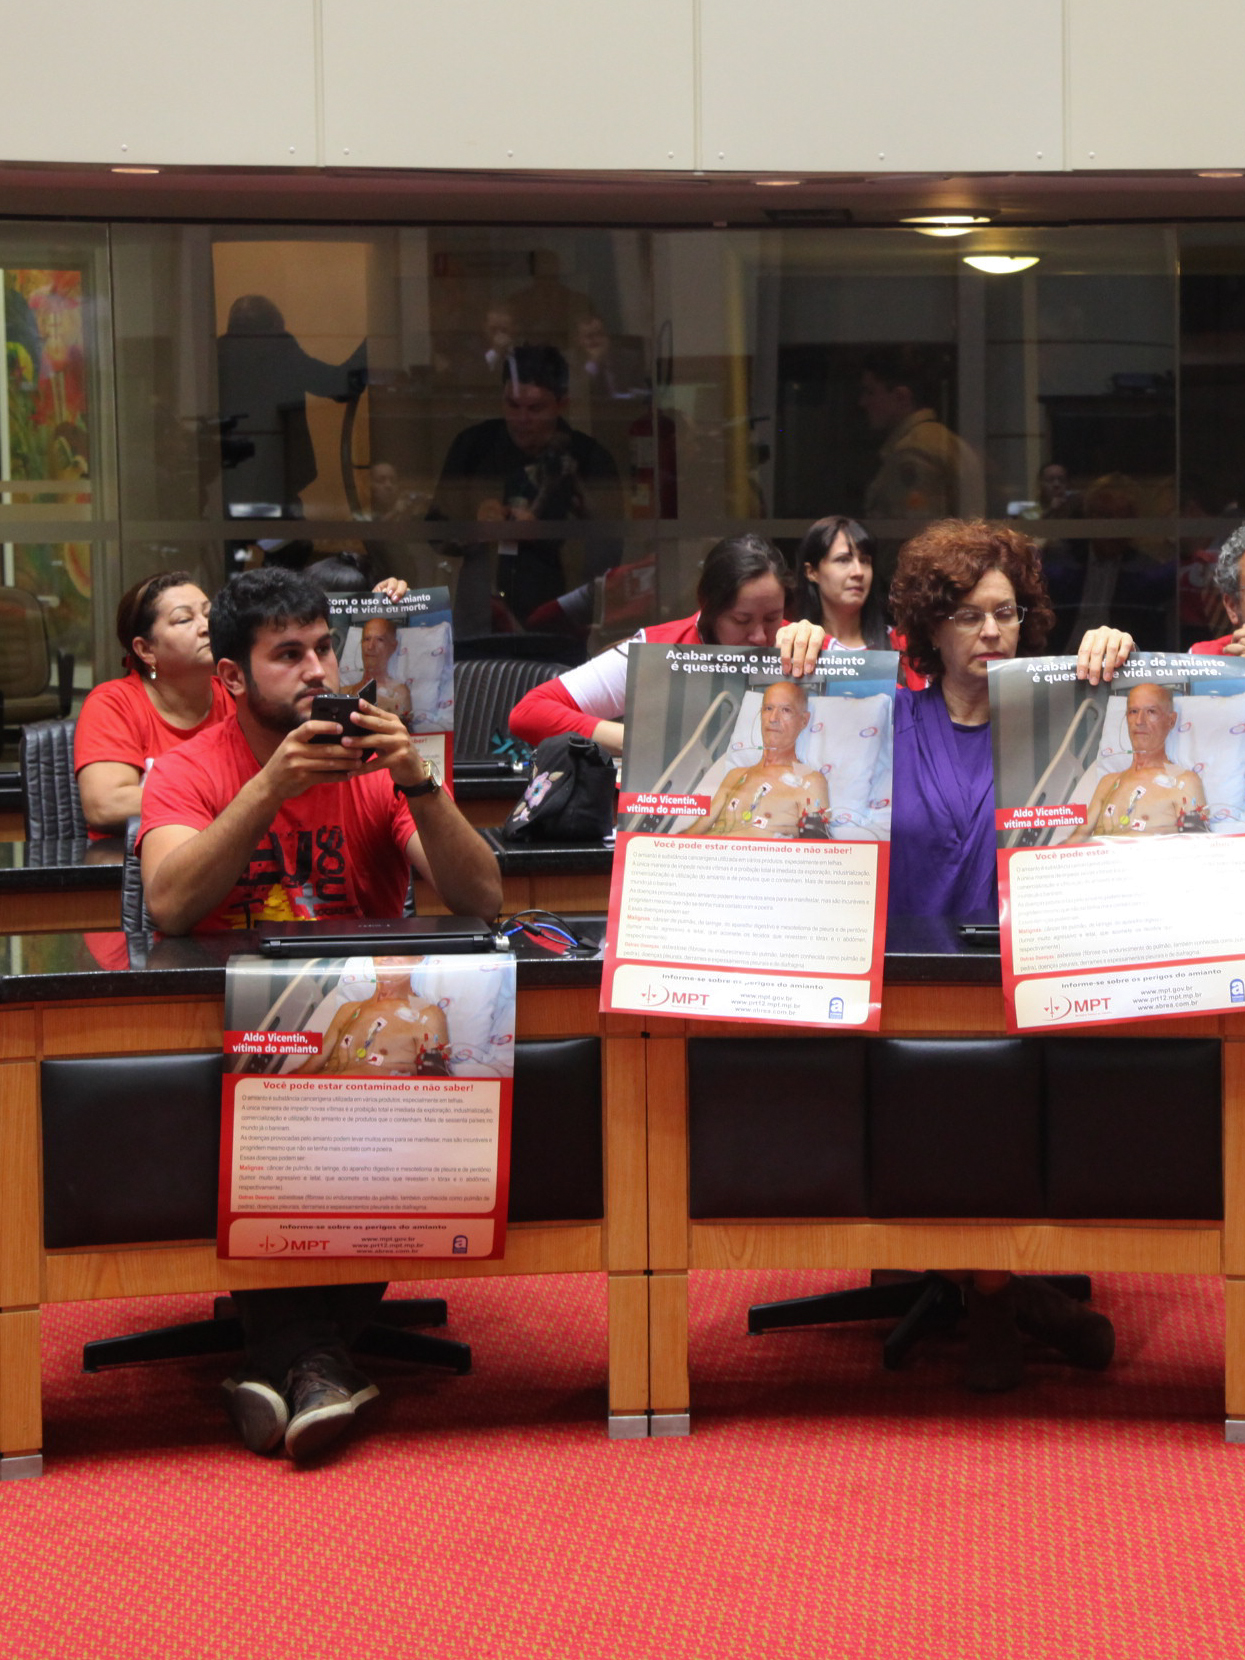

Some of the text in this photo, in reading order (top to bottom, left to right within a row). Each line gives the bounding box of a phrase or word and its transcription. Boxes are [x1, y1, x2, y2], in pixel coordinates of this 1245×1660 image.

[361, 598, 379, 606] uso
[400, 594, 431, 604] mianto
[345, 605, 359, 614] de
[361, 605, 383, 614] vida
[386, 606, 399, 614] ou
[400, 603, 429, 612] morte.
[666, 650, 713, 661] Acabar
[716, 653, 746, 663] com
[749, 654, 759, 664] o
[815, 654, 866, 665] mianto
[671, 660, 859, 676] é questão de vid morte.
[1026, 660, 1073, 673] Acabar
[1149, 657, 1167, 667] de
[1170, 656, 1226, 667] amianto
[1032, 673, 1041, 683] é
[1044, 672, 1080, 684] ques
[1123, 667, 1152, 678] vida
[1155, 668, 1173, 677] ou
[1176, 665, 1222, 676] morte.
[636, 794, 698, 806] Aldo Vicentin,
[626, 803, 707, 815] vítima do amianto
[1013, 806, 1074, 818] Aldo Vicentin,
[1003, 816, 1084, 829] vítima do amianto
[653, 840, 675, 849] Você
[678, 841, 702, 851] pode
[705, 842, 728, 851] estar
[731, 842, 793, 853] contaminado
[803, 845, 821, 854] não
[823, 846, 853, 855] saber!
[1035, 850, 1057, 861] Você
[1060, 850, 1084, 859] pode
[1061, 980, 1105, 989] Informe-se
[1106, 977, 1130, 986] sobre
[1142, 973, 1173, 983] perigos
[1187, 968, 1222, 977] amianto
[671, 991, 710, 1005] MPT
[1074, 997, 1112, 1013] MPT
[1140, 985, 1193, 996] www.mpt.gov.br
[243, 1032, 308, 1044] Aldo Vicentin,
[232, 1043, 319, 1054] vítima do amianto
[263, 1081, 286, 1090] Você
[289, 1082, 315, 1091] pode
[345, 1082, 411, 1091] contaminado
[422, 1083, 440, 1091] não
[443, 1084, 474, 1092] saber!
[291, 1240, 330, 1251] MPT
